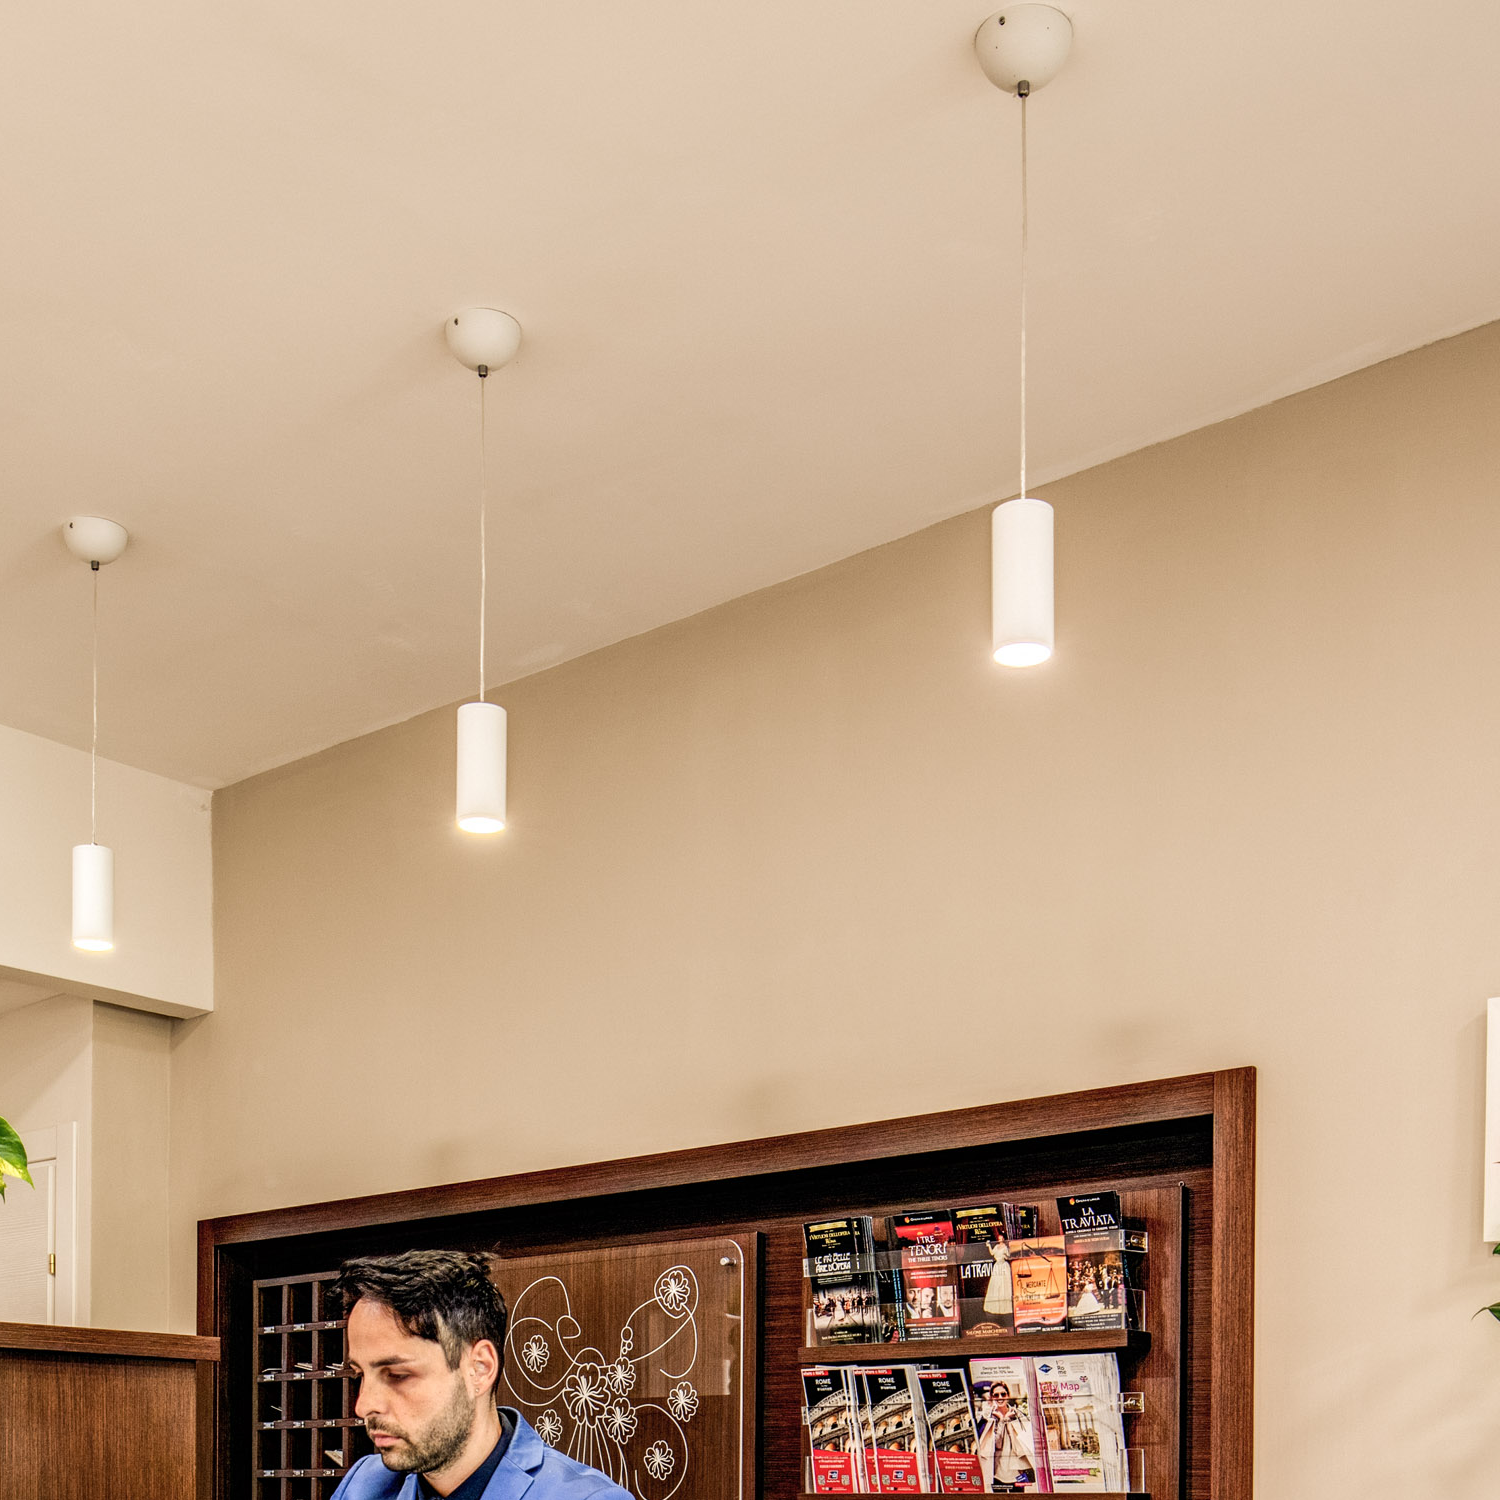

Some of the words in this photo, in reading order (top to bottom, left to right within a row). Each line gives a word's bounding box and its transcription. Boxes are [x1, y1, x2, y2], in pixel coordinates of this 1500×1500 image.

[1082, 1207, 1094, 1216] LA
[1062, 1214, 1116, 1230] TRAVIATA
[921, 1236, 935, 1244] TRE
[908, 1240, 948, 1256] TENORI
[960, 1264, 971, 1278] LA
[1060, 1382, 1080, 1392] Map
